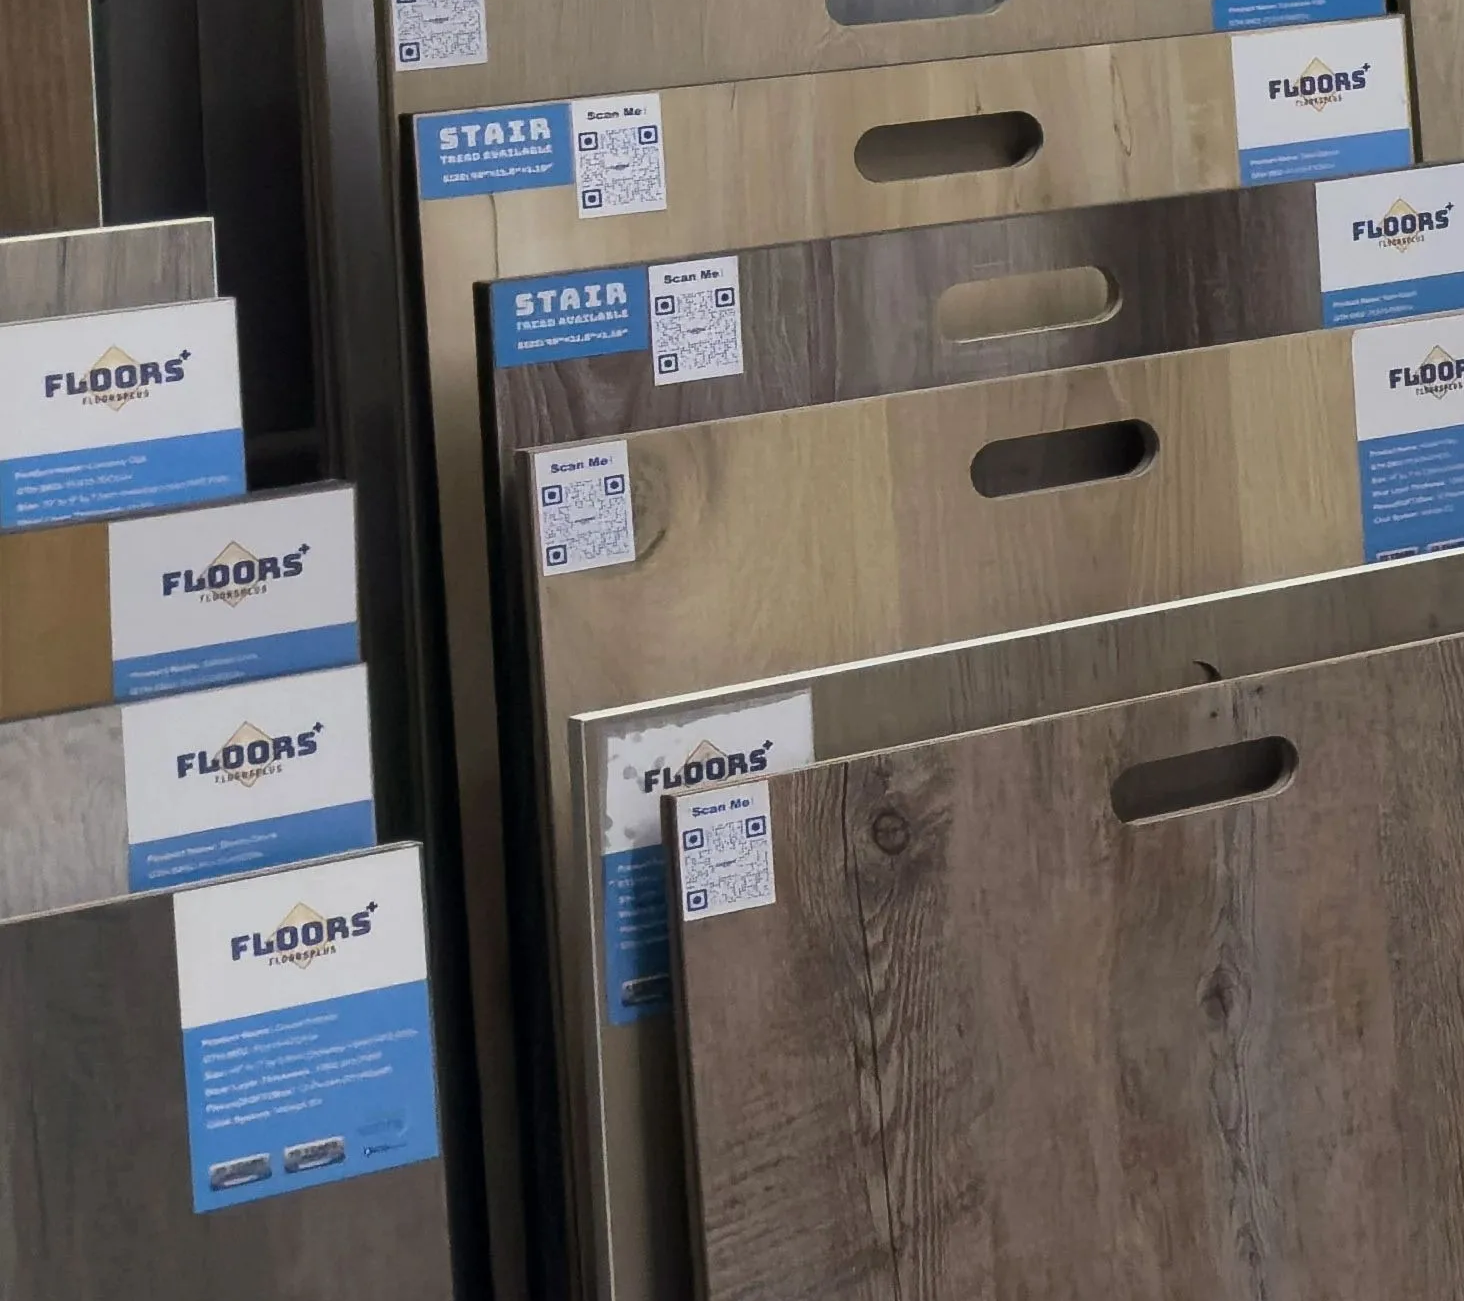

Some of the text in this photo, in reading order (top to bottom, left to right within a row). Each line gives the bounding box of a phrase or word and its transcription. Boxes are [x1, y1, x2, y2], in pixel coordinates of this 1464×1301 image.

[587, 111, 620, 121] Scan
[439, 117, 551, 151] STAIR
[516, 282, 627, 317] STAIR
[550, 462, 584, 473] Scan
[692, 804, 726, 818] Scan
